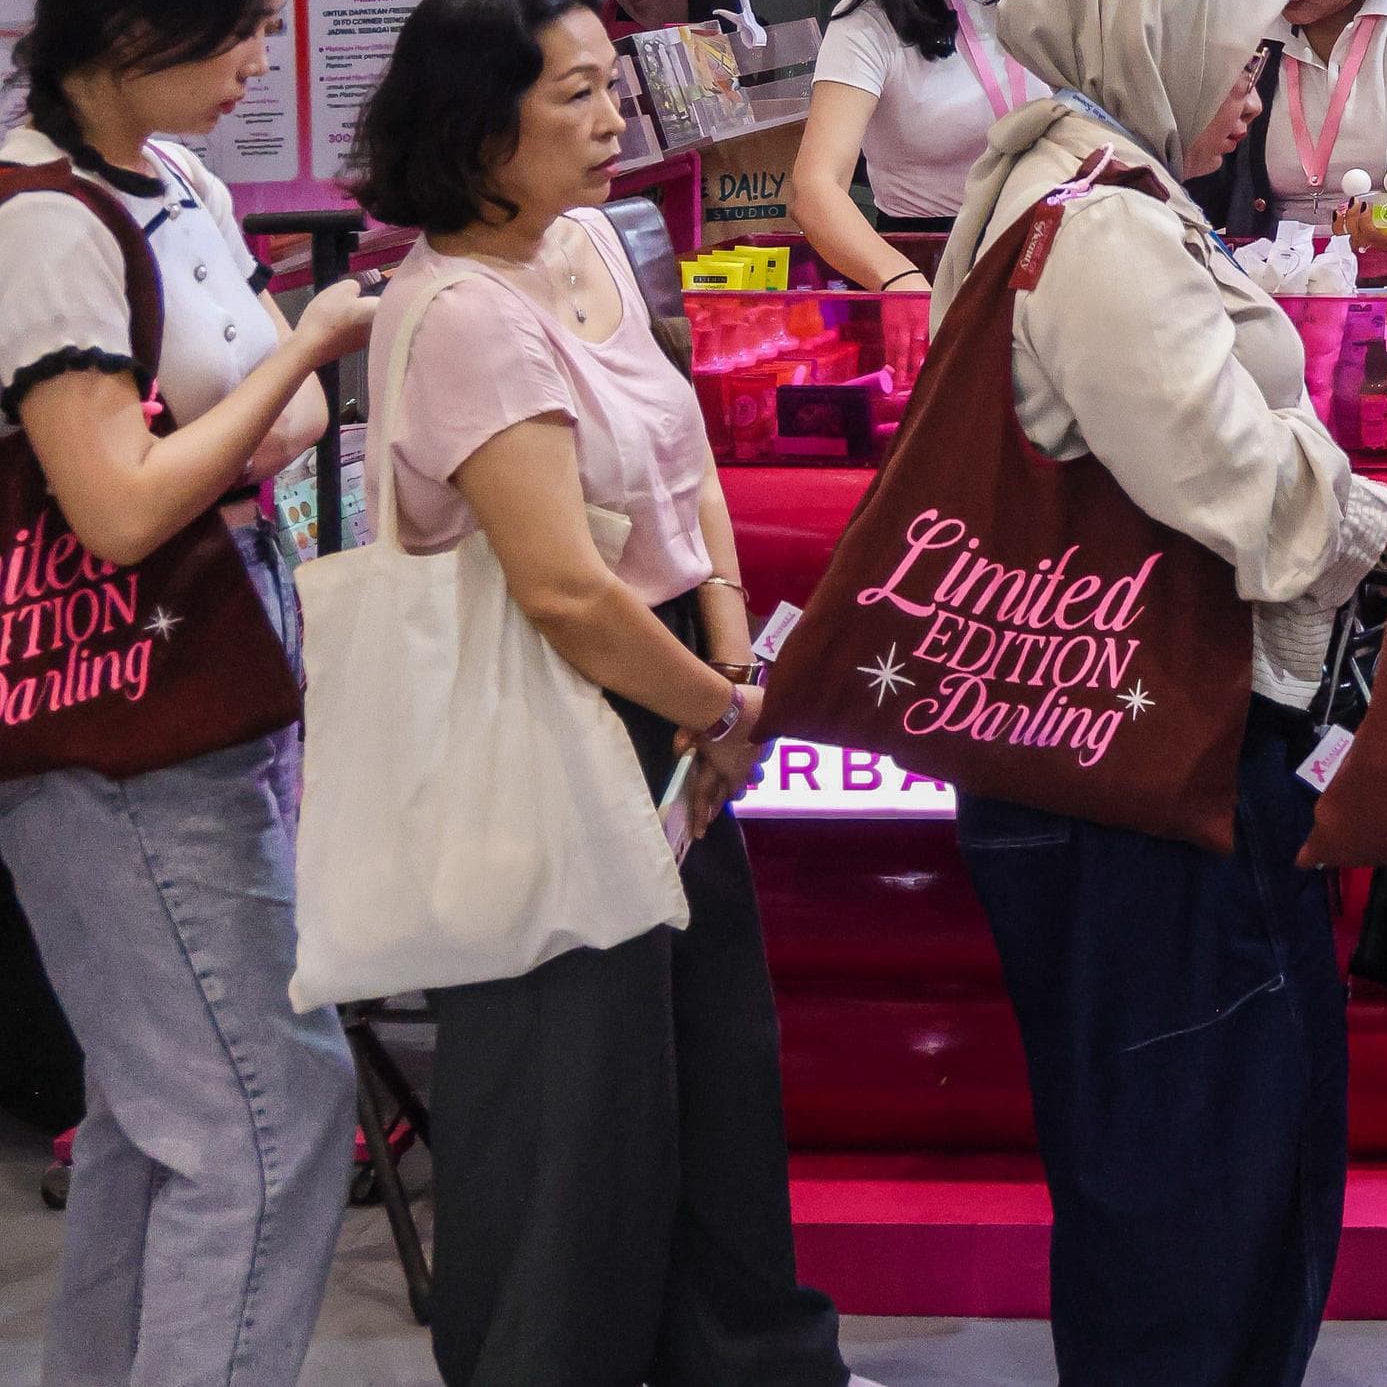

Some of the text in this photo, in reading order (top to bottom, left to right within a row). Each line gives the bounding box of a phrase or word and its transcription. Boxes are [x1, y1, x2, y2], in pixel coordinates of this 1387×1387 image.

[857, 509, 1163, 631] Limited
[914, 615, 1140, 689] EDITION
[903, 673, 1123, 767] Darling
